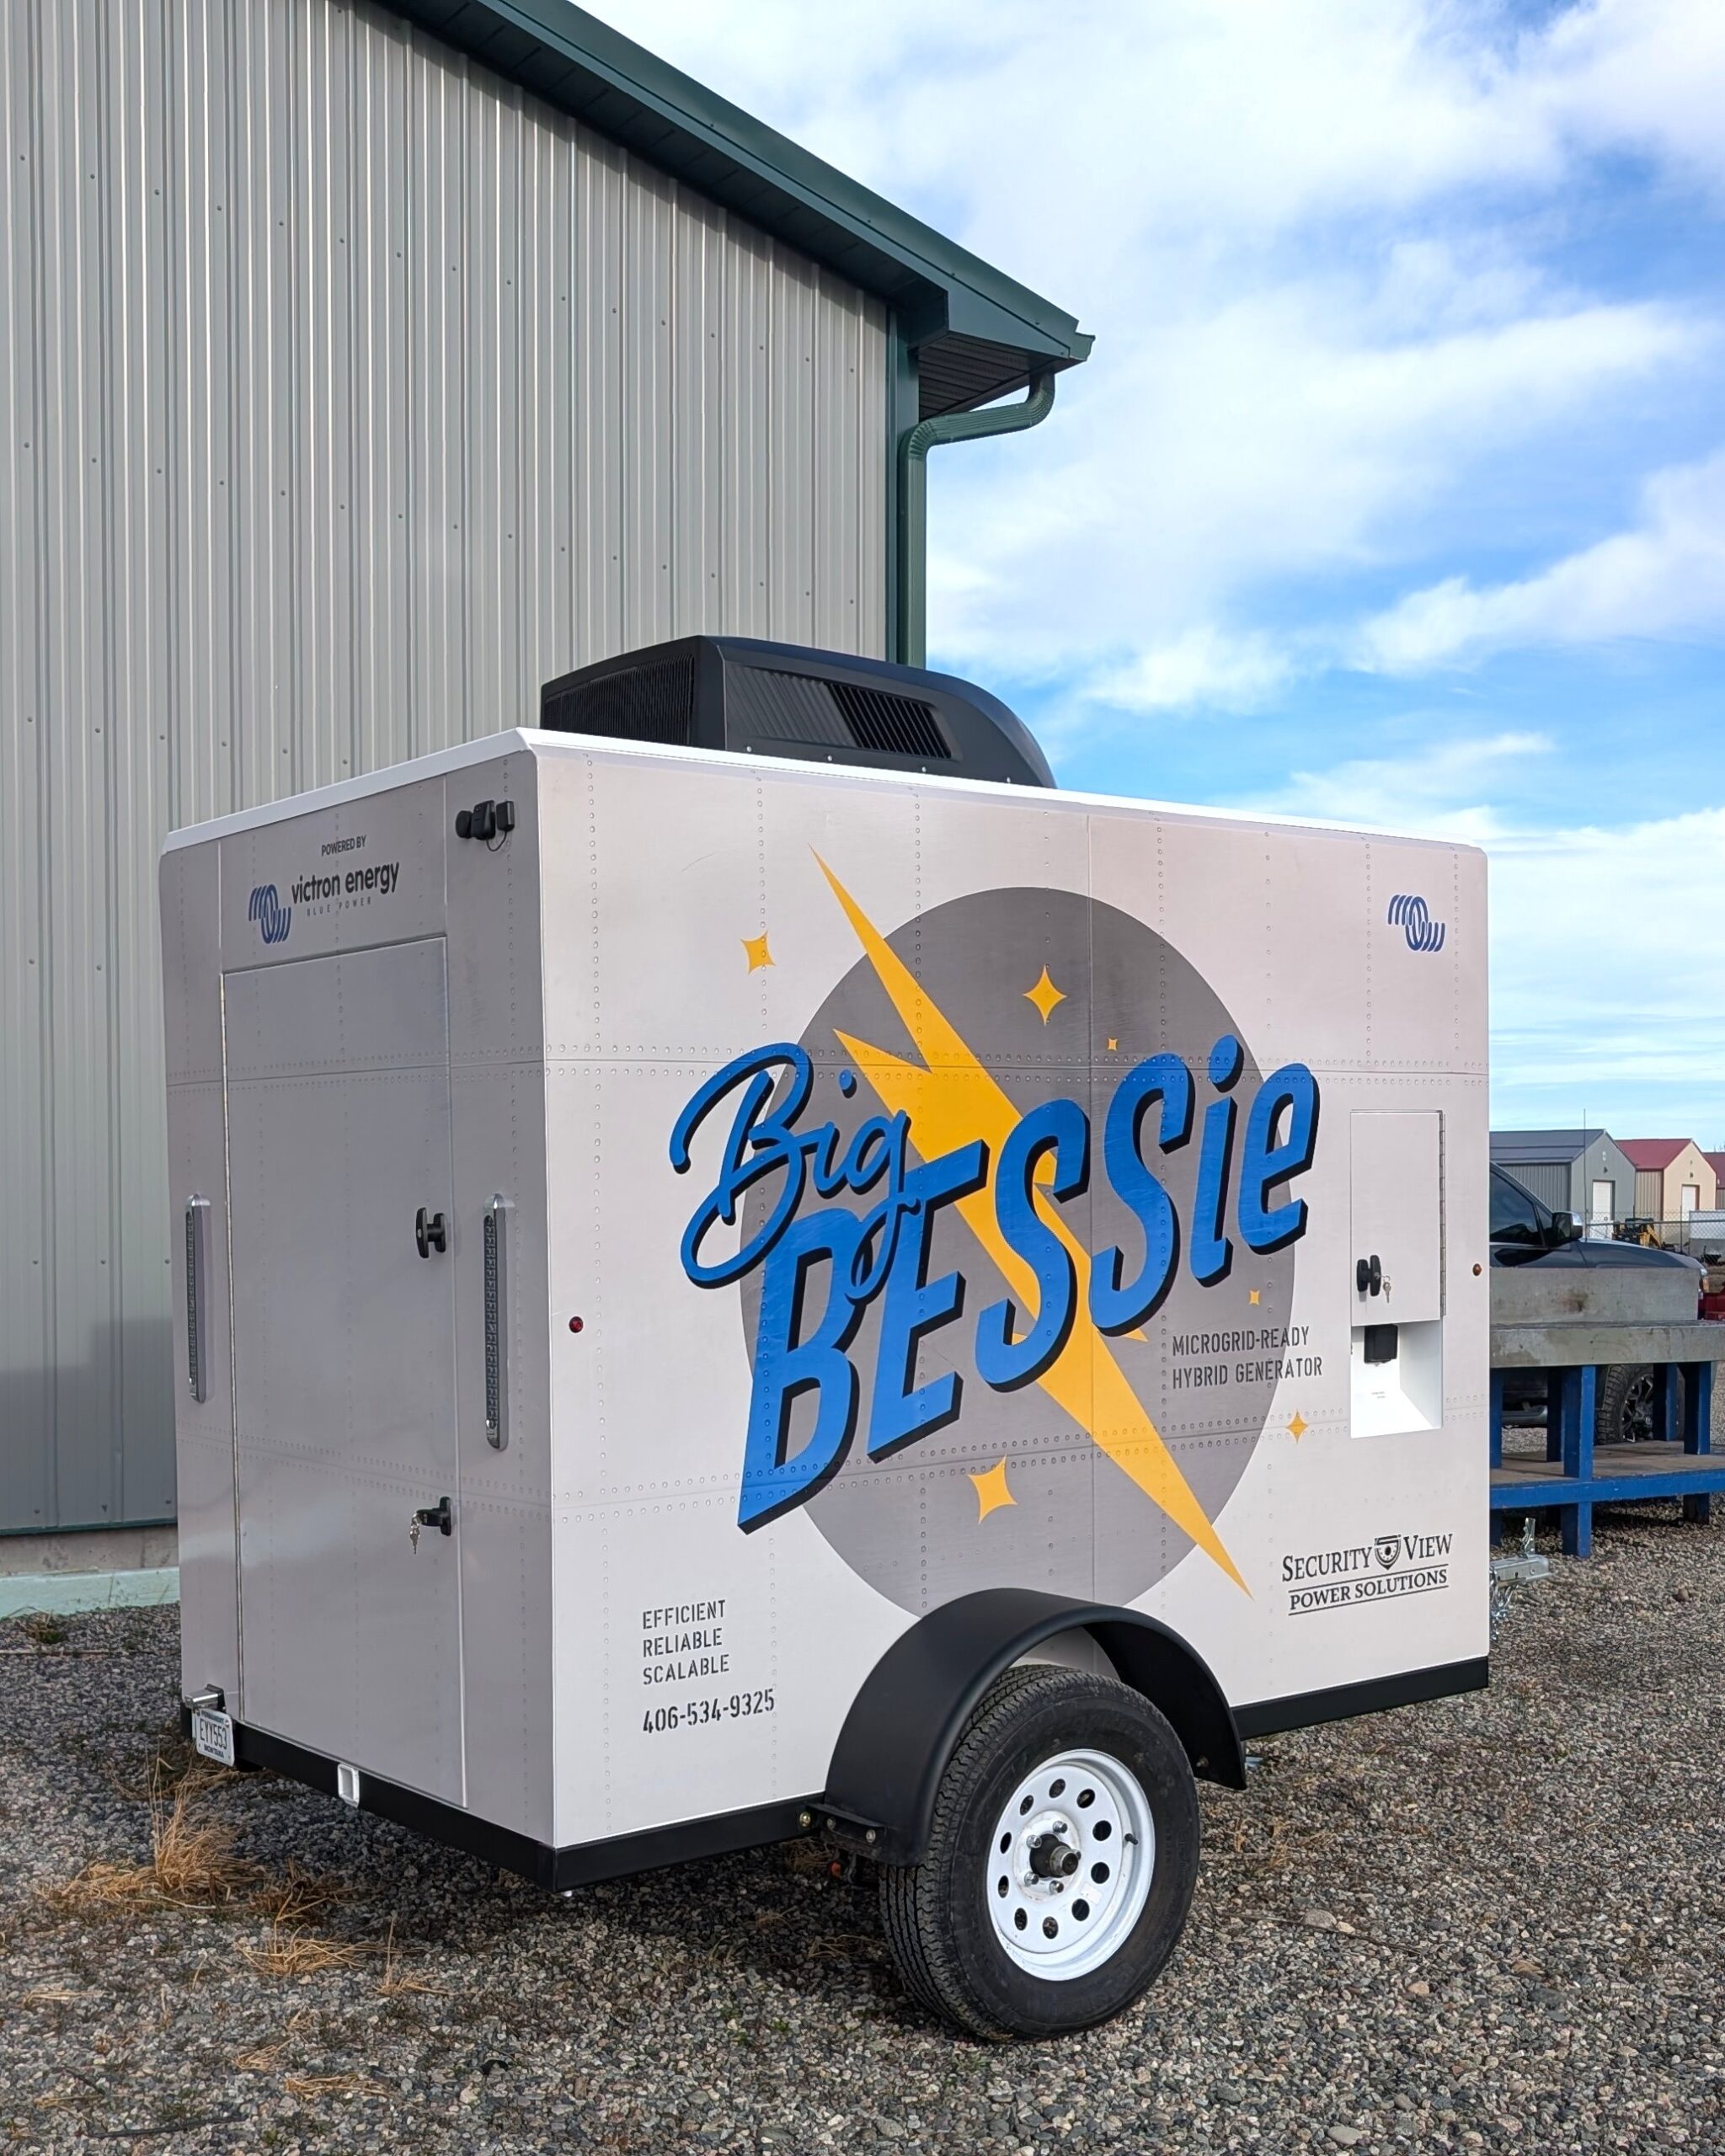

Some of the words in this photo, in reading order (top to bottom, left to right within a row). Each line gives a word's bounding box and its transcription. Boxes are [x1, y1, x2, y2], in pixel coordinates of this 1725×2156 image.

[321, 837, 355, 857] POWERED
[356, 835, 366, 848] BY
[291, 874, 341, 905] victron
[345, 862, 400, 894] energy
[307, 905, 331, 916] BLUE
[339, 897, 371, 910] POWER
[670, 1042, 921, 1304] Big
[1172, 1326, 1310, 1357] MICROGRID-READY
[1172, 1364, 1229, 1390] HYBRID
[1236, 1356, 1322, 1383] GENERATOR
[1282, 1545, 1372, 1582] SECURITY
[1403, 1533, 1453, 1561] VIEW
[1290, 1585, 1351, 1610] POWER
[1354, 1569, 1448, 1598] SOLUTIONS
[643, 1599, 726, 1630] EFFICIENT
[643, 1628, 723, 1658] RELIABLE
[643, 1654, 730, 1685] SCALABLE
[643, 1688, 775, 1733] 406-534-9325
